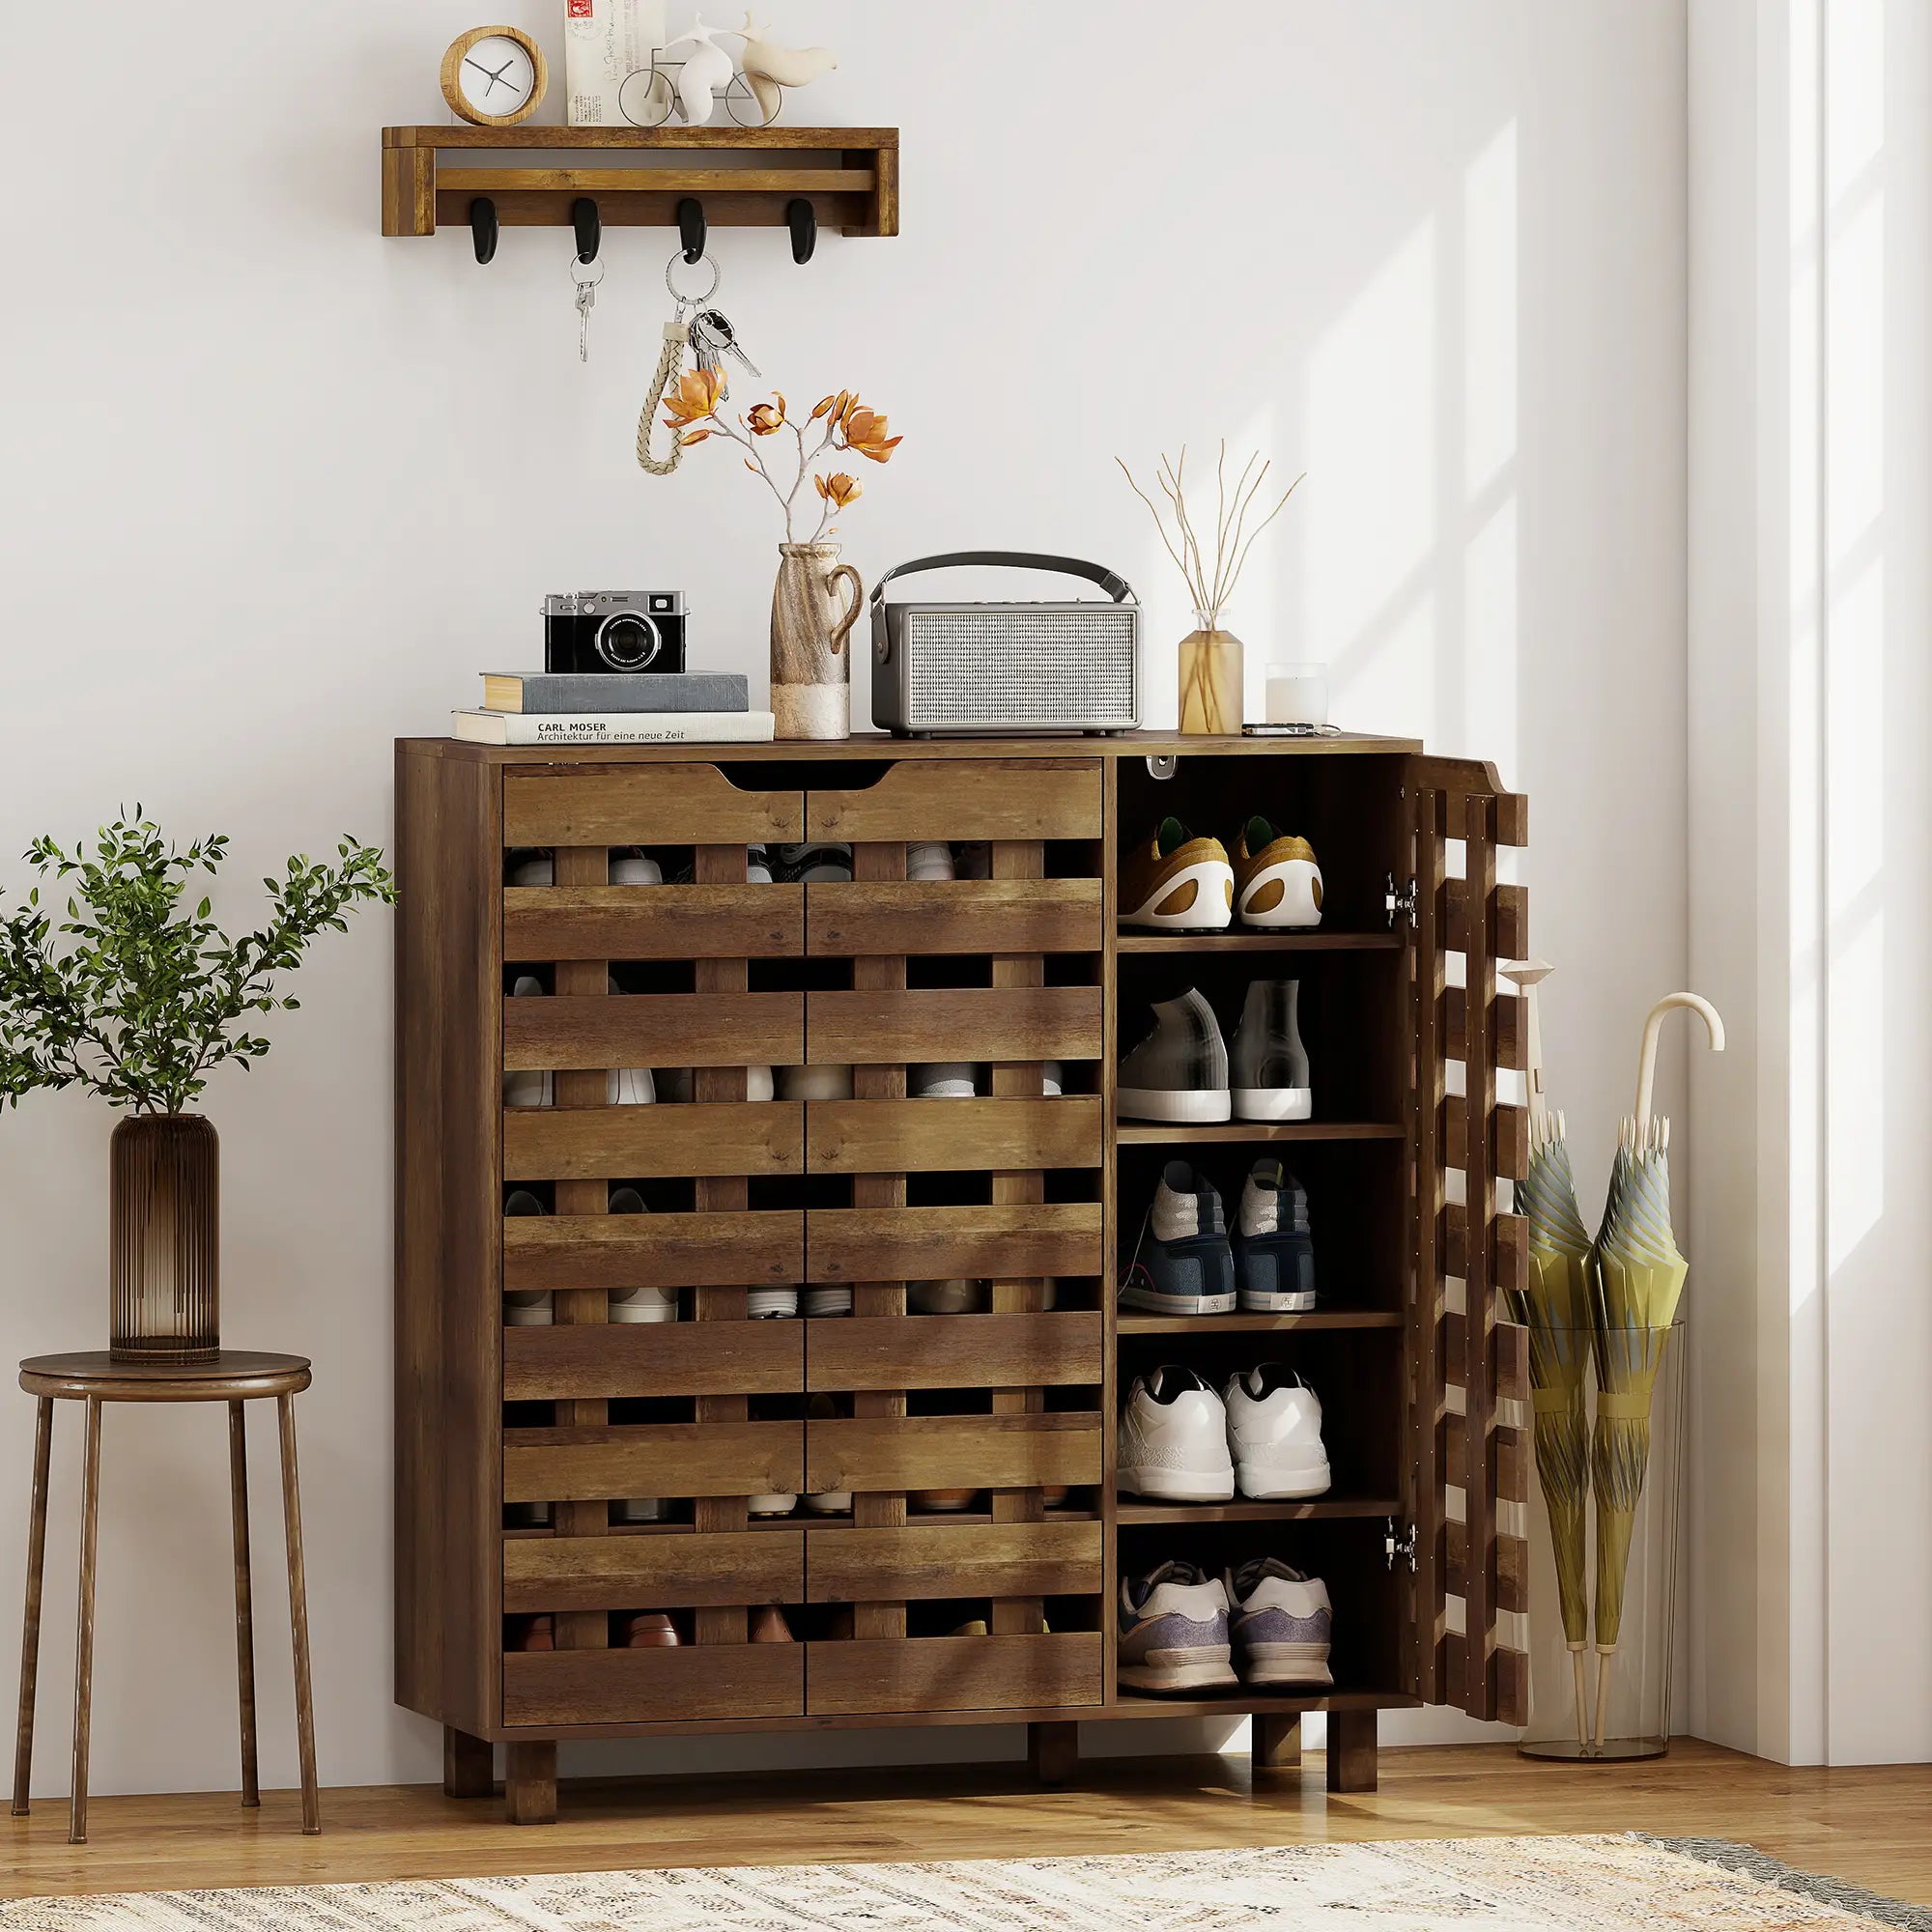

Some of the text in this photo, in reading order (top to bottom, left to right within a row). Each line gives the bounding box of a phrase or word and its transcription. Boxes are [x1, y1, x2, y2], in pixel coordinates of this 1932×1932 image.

[537, 723, 607, 732] CARL MOSER
[537, 732, 593, 741] Architektur
[596, 731, 611, 740] für
[613, 731, 636, 740] eine
[665, 730, 685, 739] Zeit
